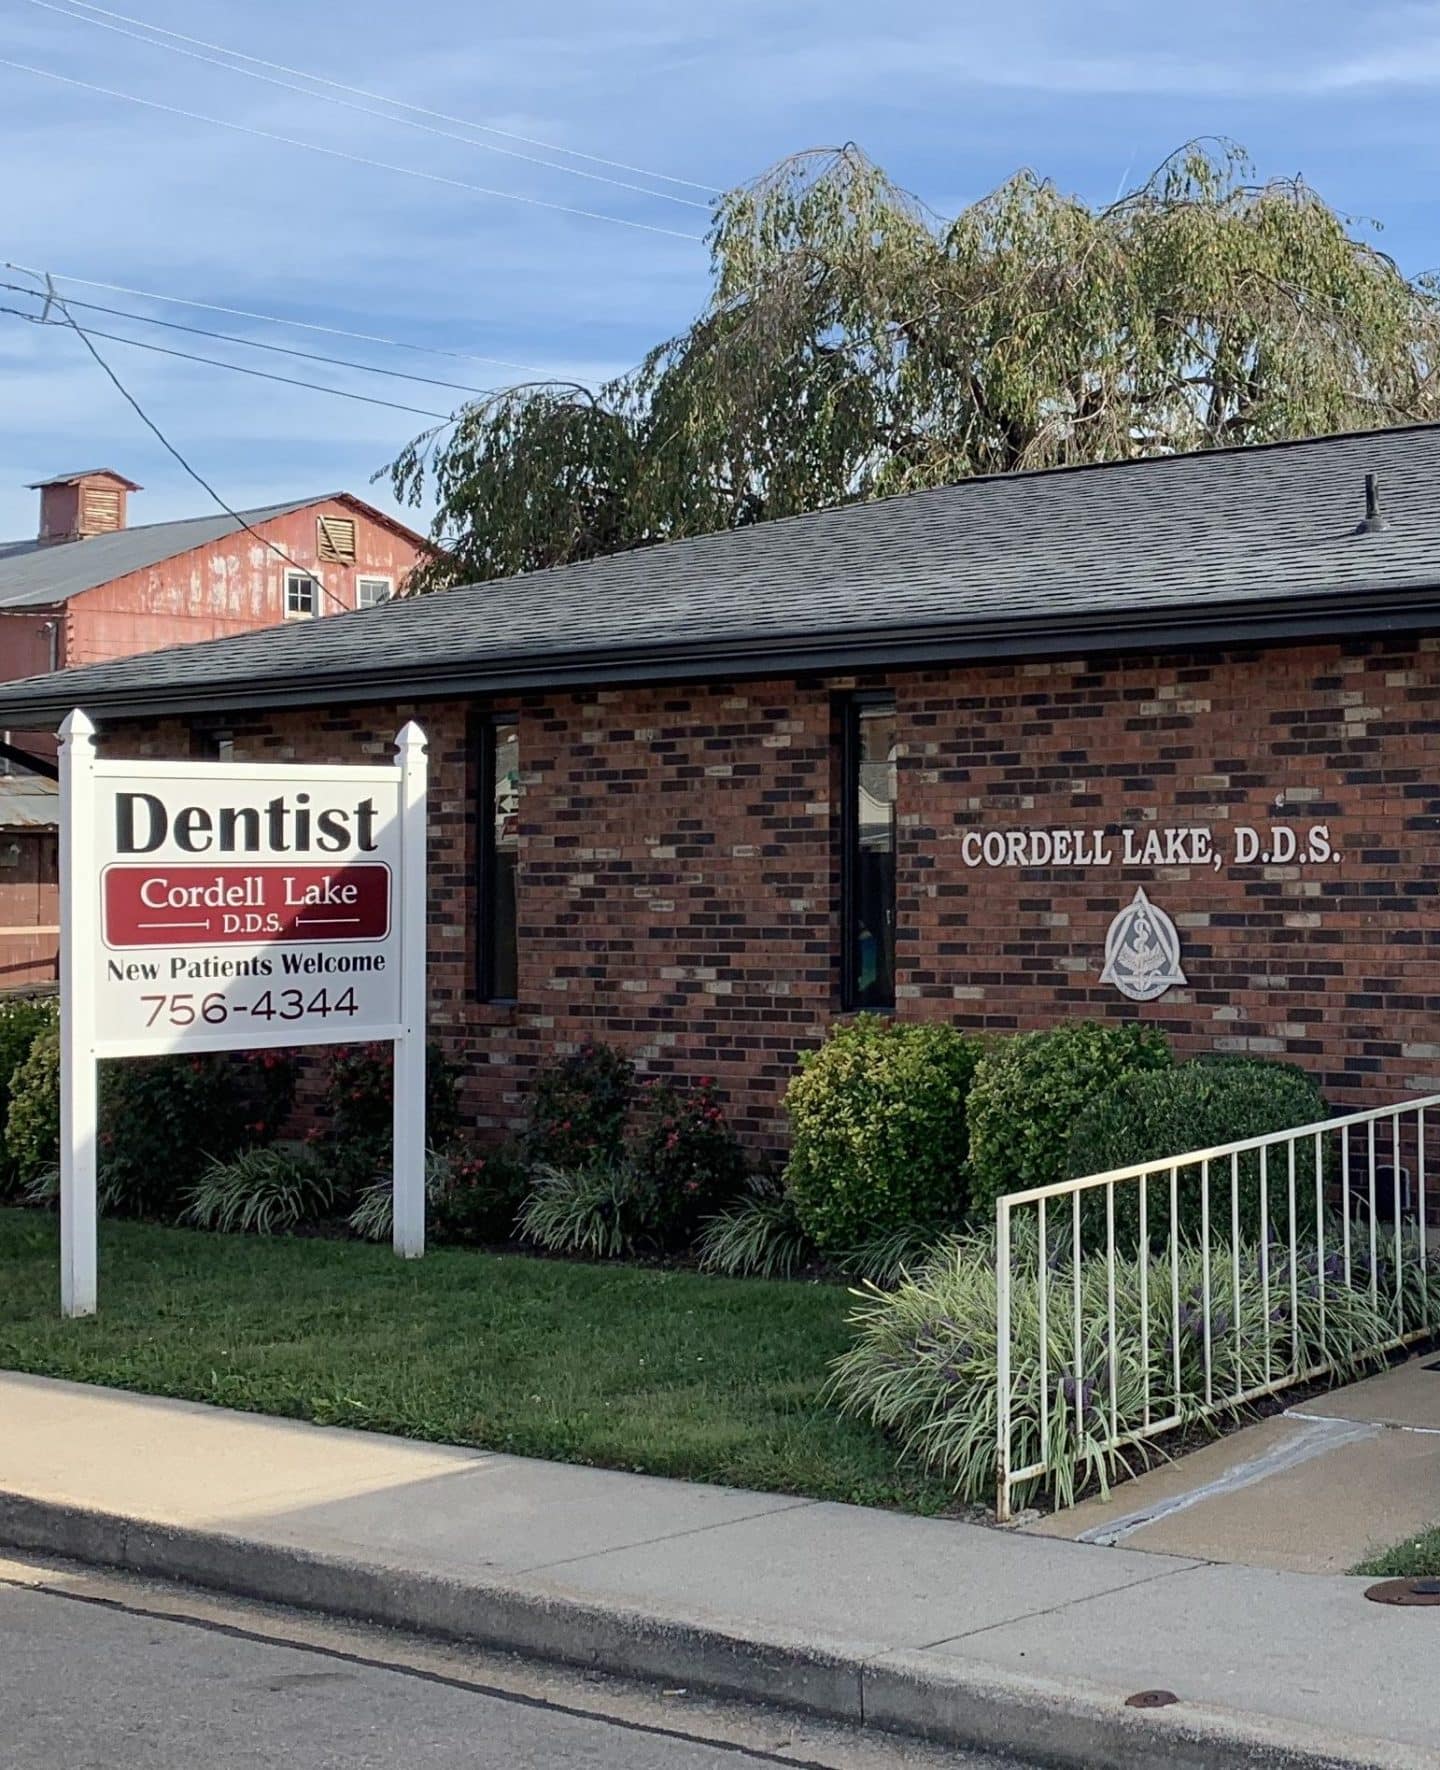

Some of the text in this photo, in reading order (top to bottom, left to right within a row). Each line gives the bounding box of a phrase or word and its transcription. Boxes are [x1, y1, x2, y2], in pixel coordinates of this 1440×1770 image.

[115, 792, 379, 853] Dentist
[961, 825, 1343, 872] CORDELL LAKE, D.D.S.
[140, 875, 359, 909] Cordell Lake
[222, 913, 284, 934] D.D.S.
[107, 952, 386, 981] New Patients Welcome
[140, 987, 360, 1028] 756-4344
